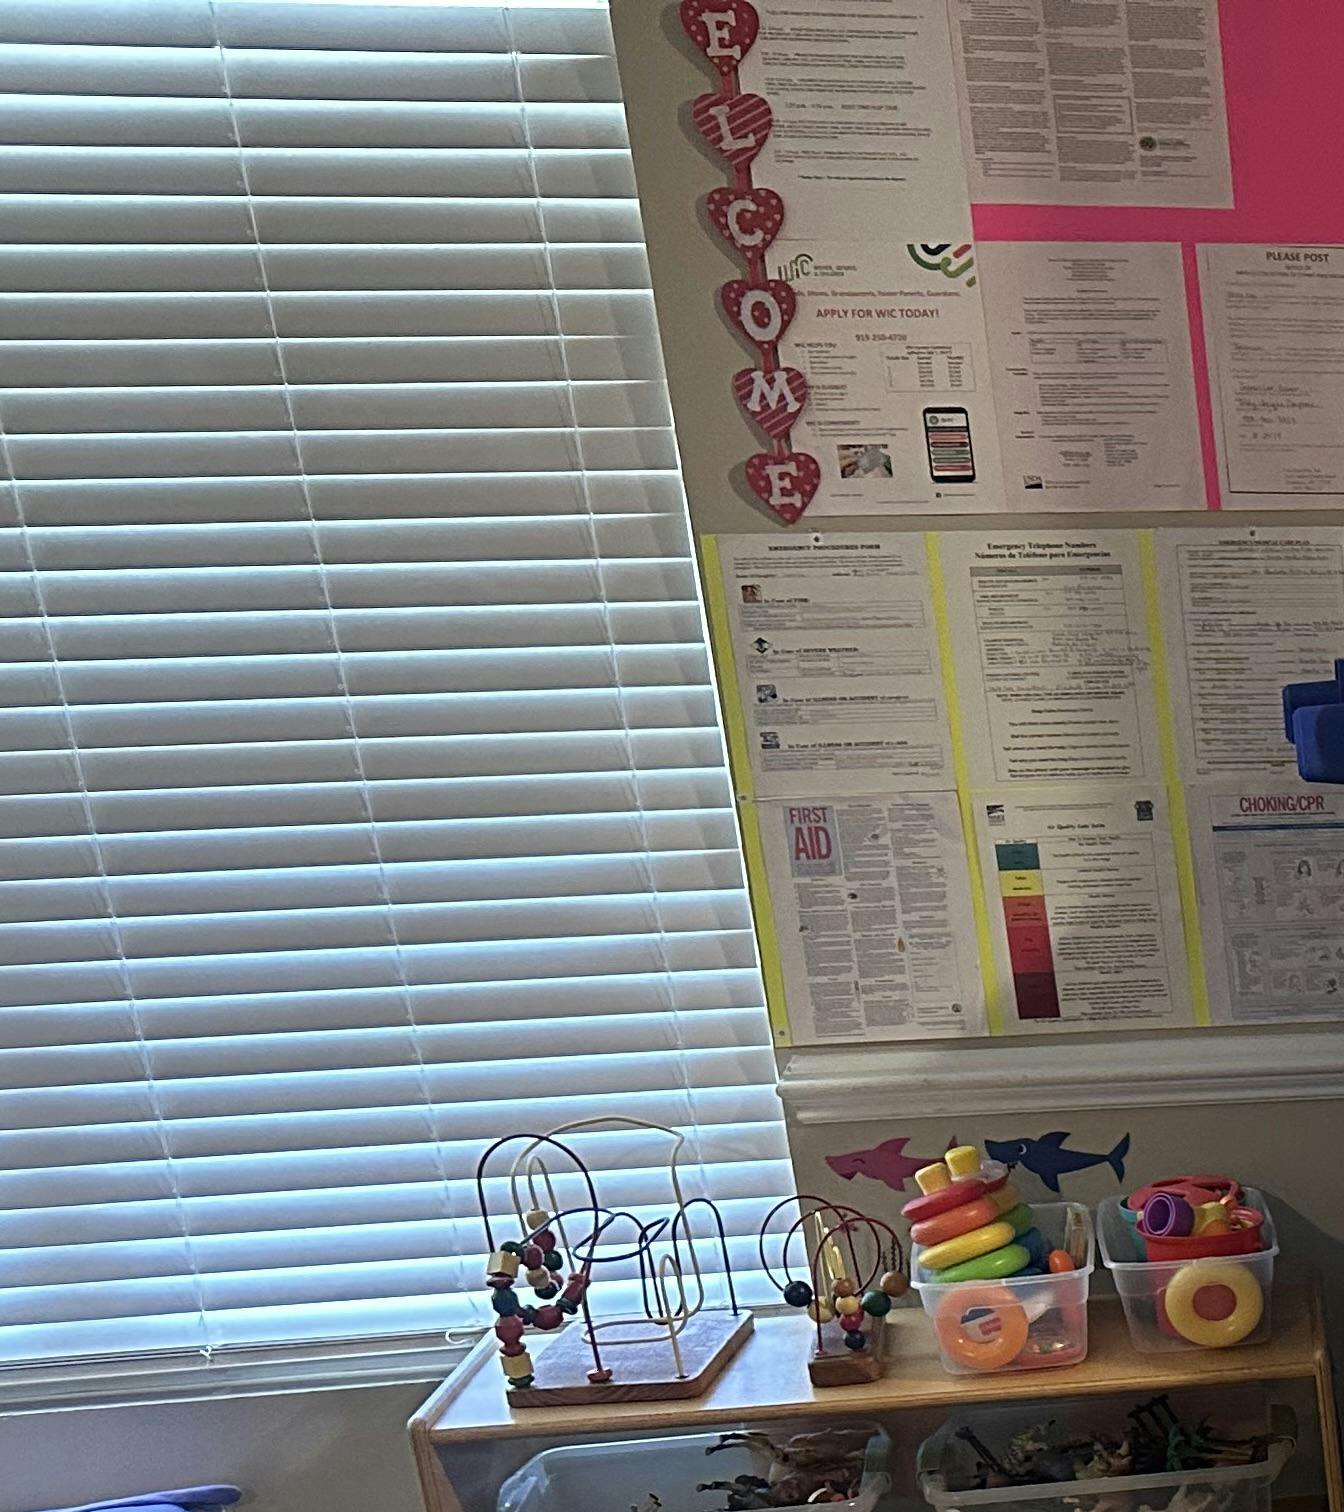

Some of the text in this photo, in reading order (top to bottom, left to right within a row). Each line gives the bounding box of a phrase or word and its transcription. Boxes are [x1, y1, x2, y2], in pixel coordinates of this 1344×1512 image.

[1266, 252, 1329, 263] PLEASE POST
[816, 309, 939, 318] APPLY FOR WIC TODAY!
[987, 543, 1026, 551] Emergency
[1240, 795, 1325, 813] CHOKING/CPR
[789, 808, 827, 824] FIRST
[794, 826, 832, 861] AID
